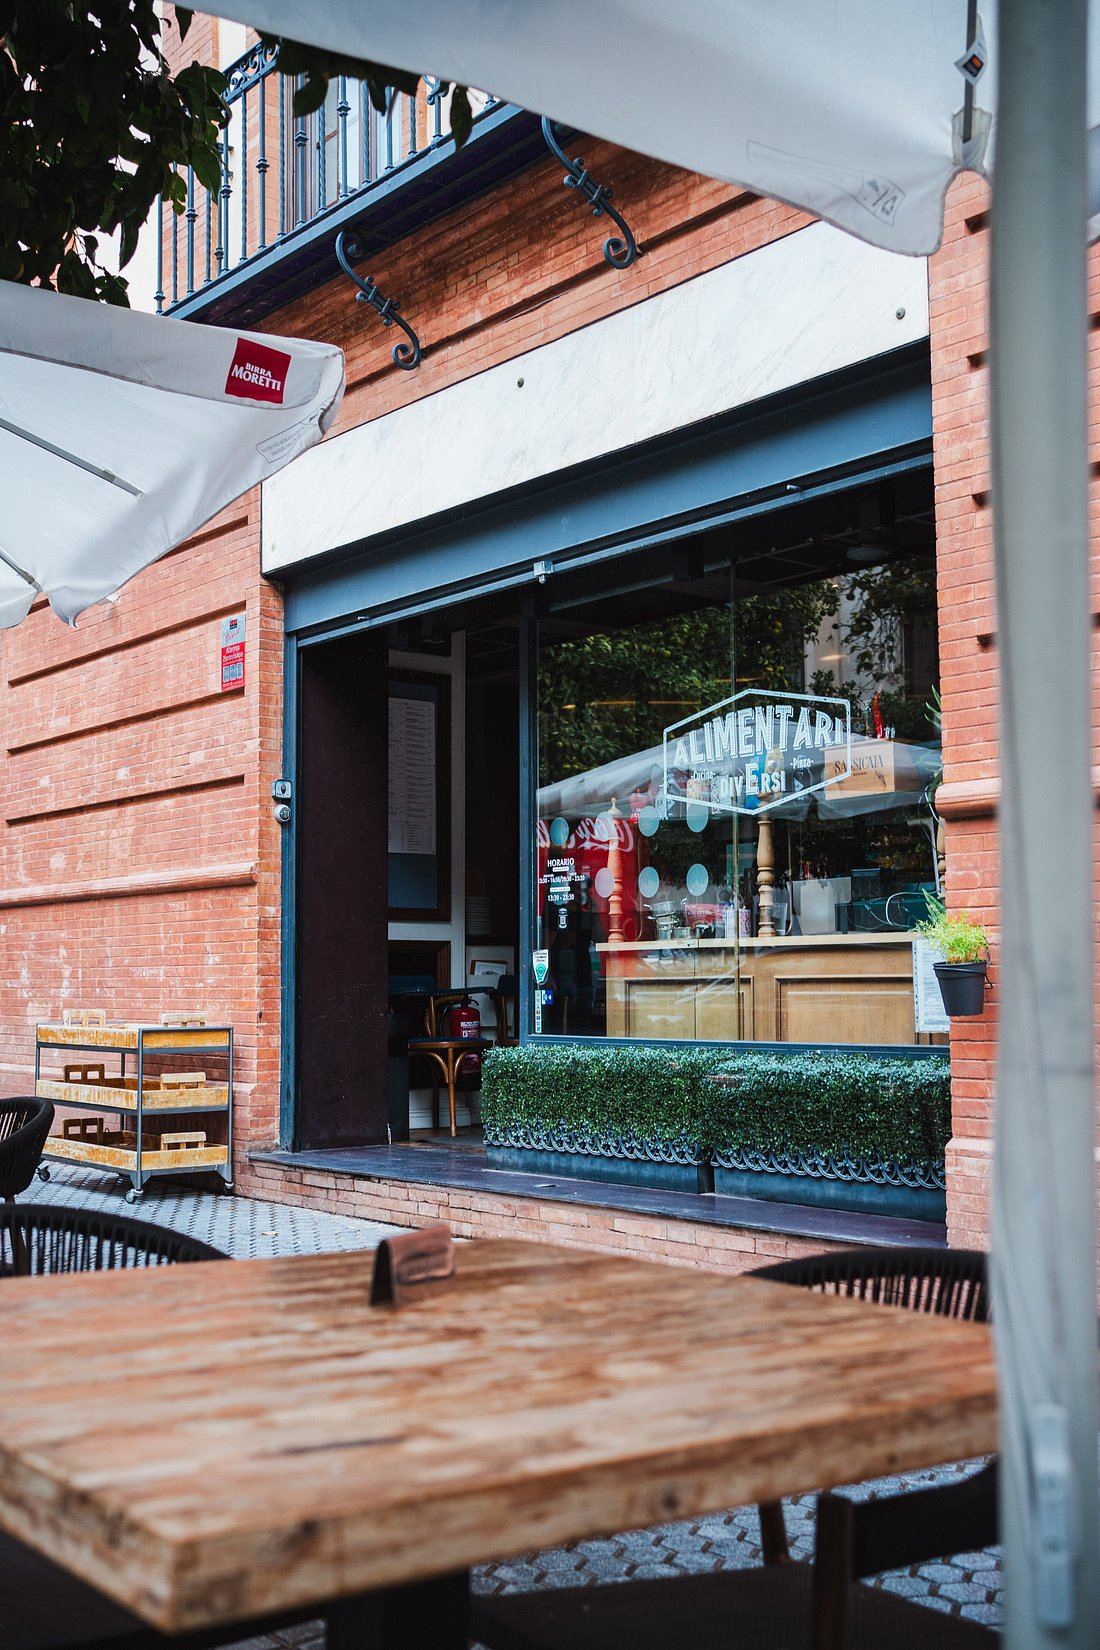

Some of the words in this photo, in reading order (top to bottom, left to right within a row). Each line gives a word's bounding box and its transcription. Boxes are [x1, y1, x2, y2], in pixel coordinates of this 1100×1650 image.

[231, 364, 281, 391] MORETTI
[246, 362, 272, 378] BIRRA
[673, 705, 844, 766] ALIMENTARI
[834, 755, 884, 774] SASICAIA
[720, 763, 787, 798] DIVERSI
[547, 857, 575, 868] HORARIO
